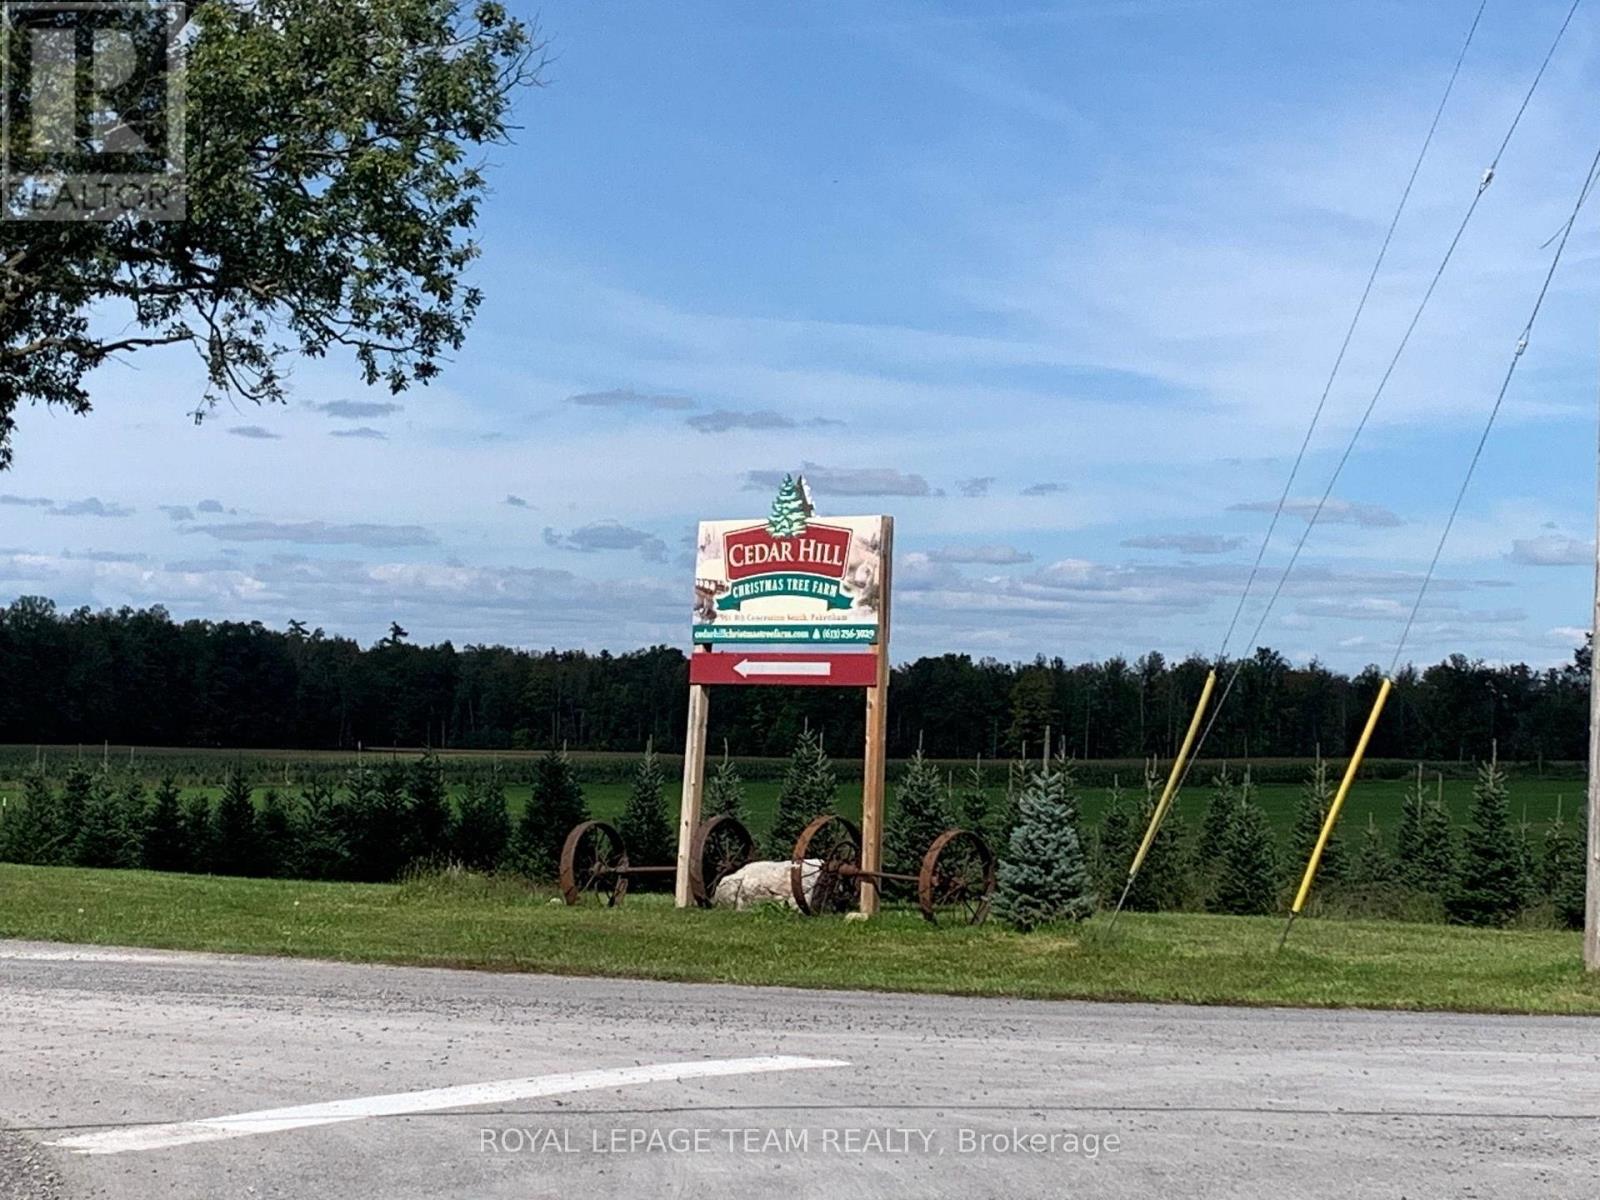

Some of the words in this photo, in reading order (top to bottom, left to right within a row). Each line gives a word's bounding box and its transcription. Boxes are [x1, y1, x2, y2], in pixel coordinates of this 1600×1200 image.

[728, 541, 794, 567] CEDAR
[799, 538, 843, 566] HILL
[732, 578, 784, 598] CHRISTMAS
[786, 578, 810, 592] TREE
[812, 580, 838, 598] FARM
